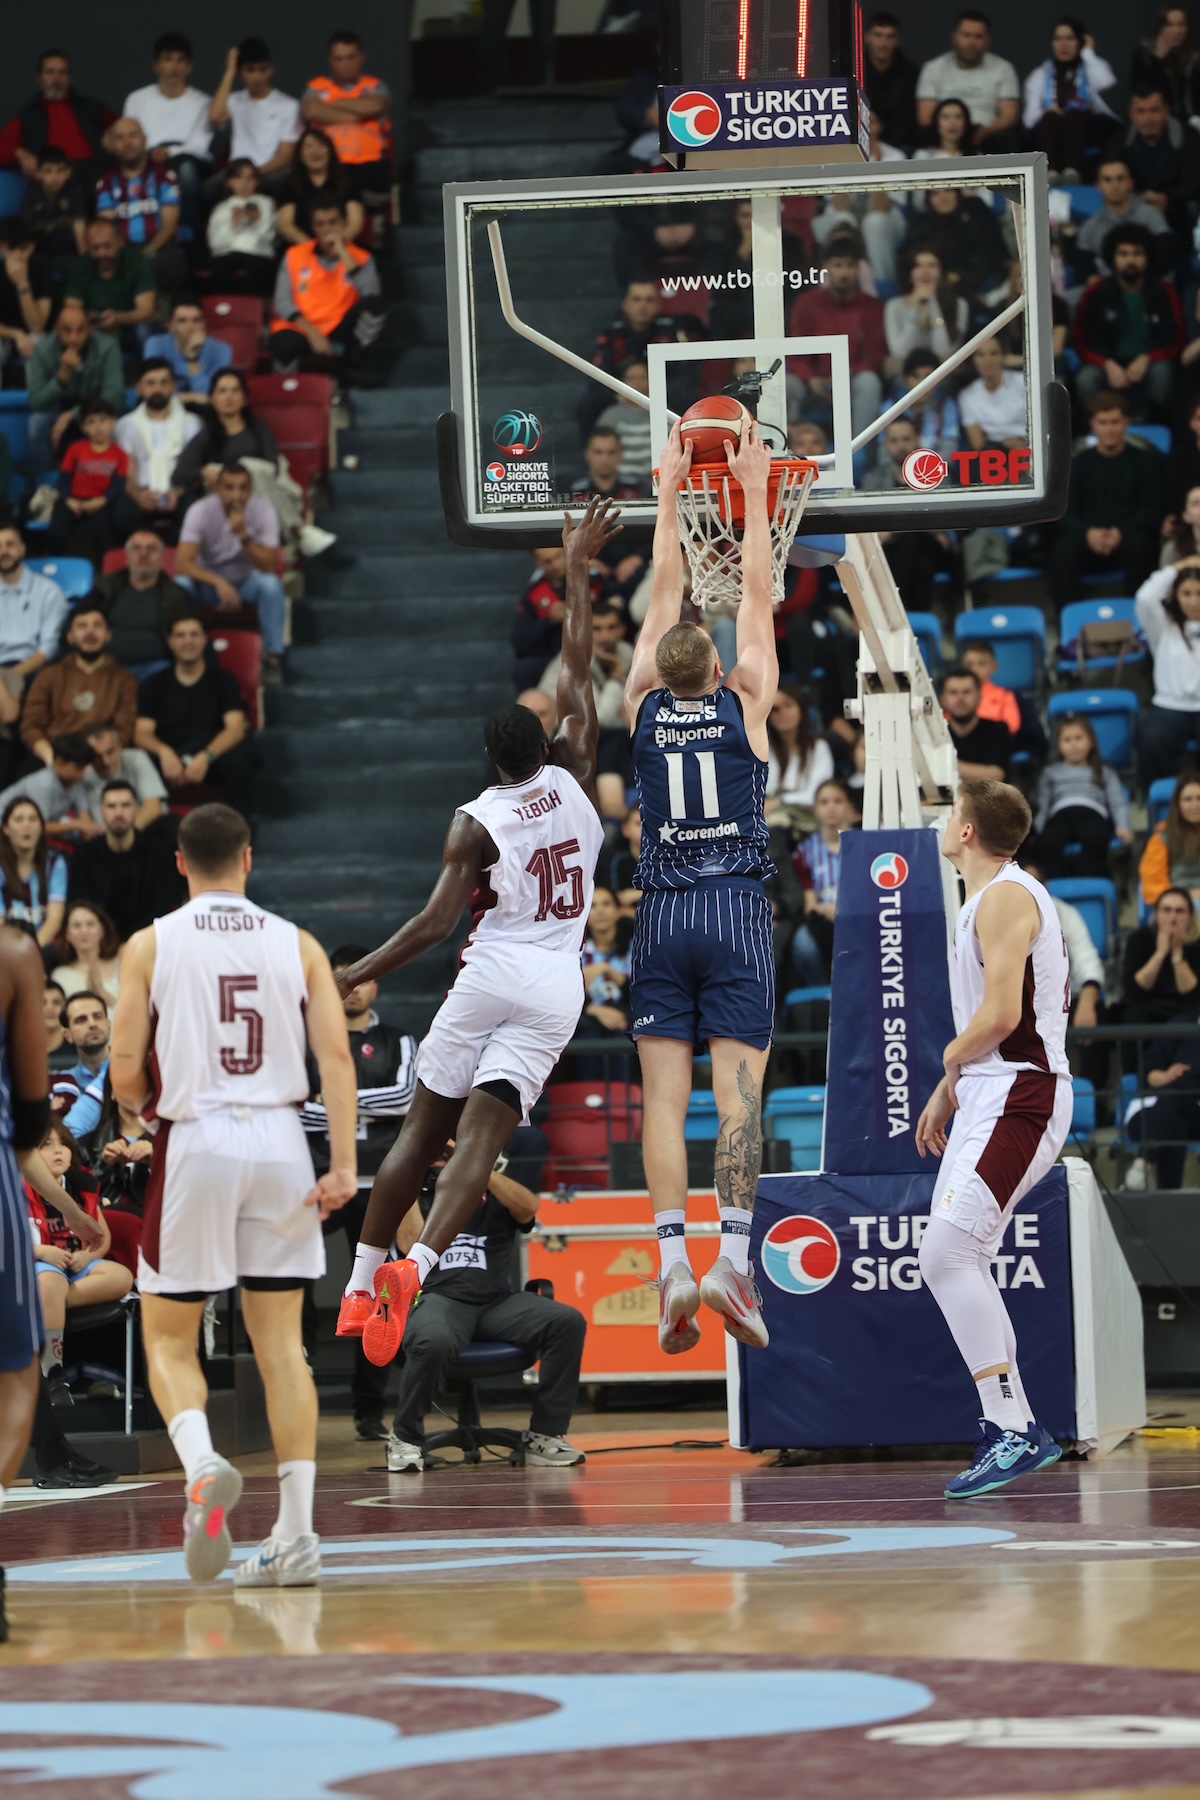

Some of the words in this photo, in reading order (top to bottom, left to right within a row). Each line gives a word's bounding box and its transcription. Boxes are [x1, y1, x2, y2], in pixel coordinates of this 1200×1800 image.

[661, 267, 828, 291] www.tbf.org.tr
[950, 448, 1031, 486] TBF
[484, 482, 552, 492] BASKETBOL
[486, 492, 525, 503] SÜPER
[655, 725, 725, 747] Bilyoner
[663, 752, 720, 819] 11
[512, 789, 562, 821] YEBOH
[677, 821, 739, 841] corendon
[525, 838, 585, 922] 15
[195, 914, 266, 931] ULUSOY
[219, 975, 263, 1075] 5
[851, 1255, 1046, 1291] SİGTA
